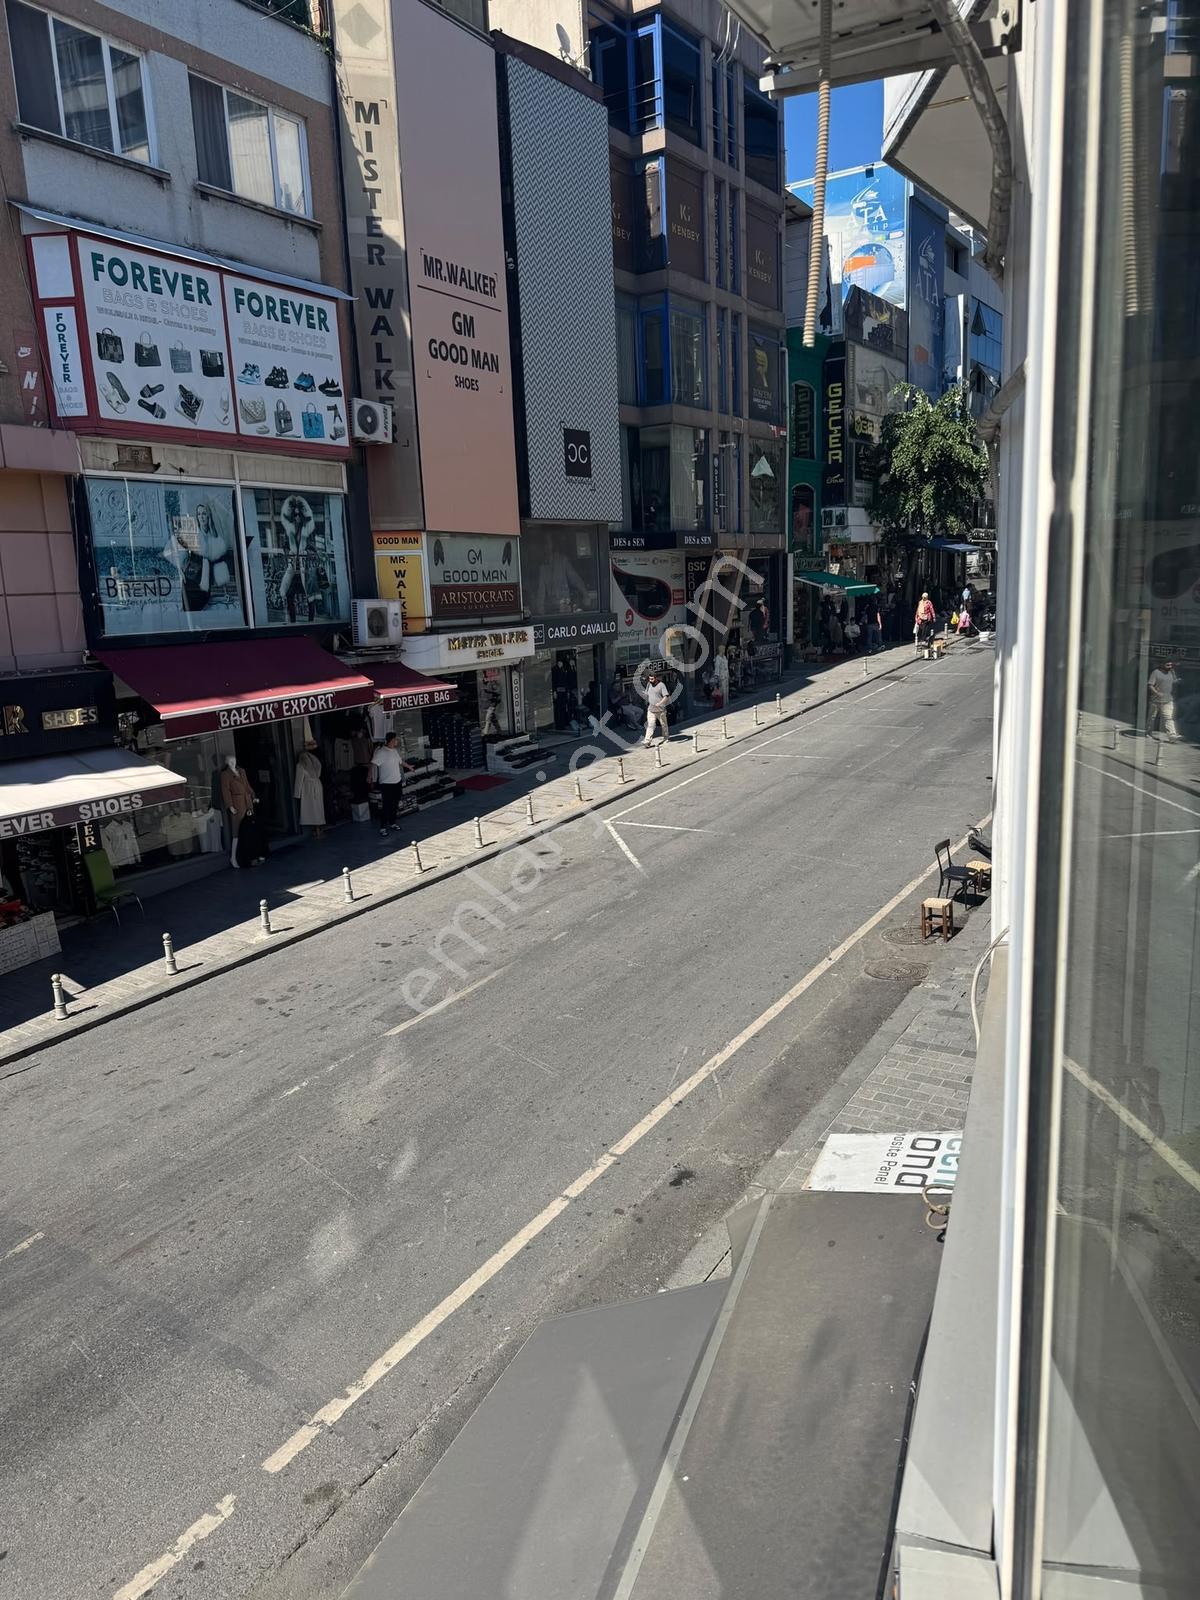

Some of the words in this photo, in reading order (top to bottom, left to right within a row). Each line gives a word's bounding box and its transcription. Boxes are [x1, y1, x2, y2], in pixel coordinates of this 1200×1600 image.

[354, 101, 387, 267] MISTER
[847, 205, 889, 226] ATA
[613, 225, 632, 240] BEY
[671, 223, 700, 242] KENBEY
[90, 251, 213, 305] FOREVER
[423, 254, 496, 298] MR.WALKER
[103, 288, 144, 310] BAGS
[147, 297, 158, 312] &
[160, 300, 208, 322] SHOES
[233, 287, 330, 333] FOREVER
[451, 311, 475, 338] GM
[56, 312, 71, 383] FOREVER
[428, 338, 469, 366] GOOD
[471, 348, 499, 373] MAN
[364, 287, 399, 443] WALK
[454, 375, 480, 391] SHOES
[376, 536, 399, 545] GOOD
[401, 536, 419, 545] MAN
[613, 537, 627, 547] DES
[633, 537, 645, 546] SEN
[684, 535, 696, 545] DES
[701, 535, 712, 545] SEN
[390, 555, 409, 565] MR.
[688, 561, 706, 572] GSC
[106, 576, 171, 598] BREND
[443, 570, 478, 583] GOOD
[482, 569, 508, 582] MAN
[440, 590, 514, 605] ARISTOCRATS
[548, 625, 577, 639] CARLO
[580, 621, 616, 636] CAVALLO
[282, 693, 334, 717] EXPORT
[390, 693, 430, 709] FOREVER
[434, 690, 451, 702] BAG
[0, 704, 30, 735] R
[44, 708, 97, 728] SHOES
[78, 793, 144, 820] SHOES
[874, 1160, 898, 1185] Panel
